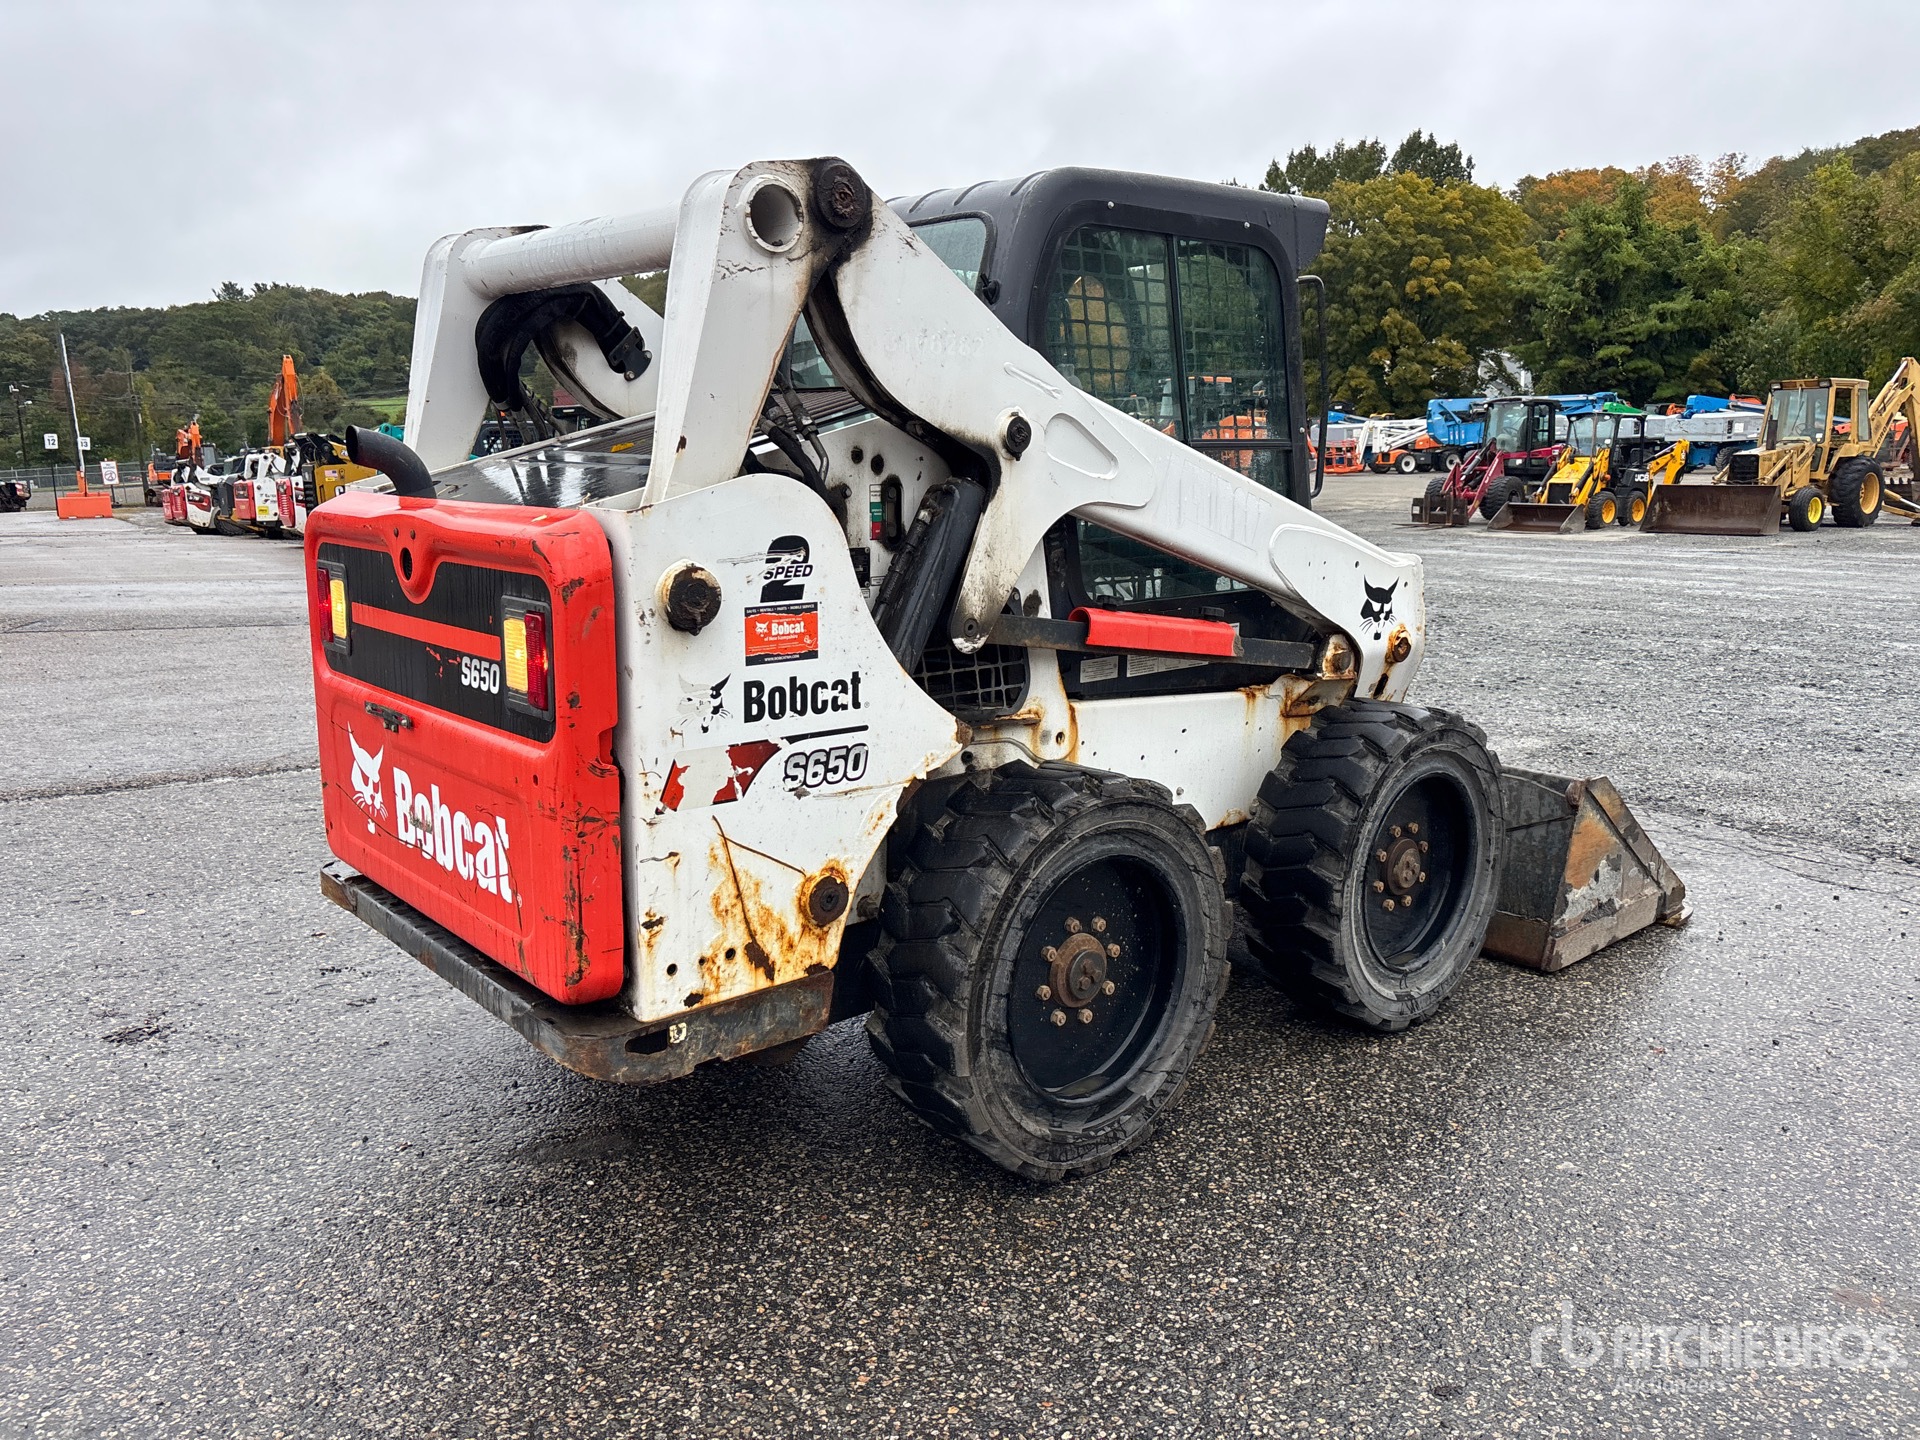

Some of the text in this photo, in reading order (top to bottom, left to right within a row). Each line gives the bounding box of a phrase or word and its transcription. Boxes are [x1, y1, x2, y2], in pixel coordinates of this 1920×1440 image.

[47, 438, 56, 446] 12
[1634, 473, 1649, 483] JCB
[760, 535, 810, 603] 2
[763, 564, 813, 580] SPEED
[772, 622, 804, 636] Bobcat
[461, 656, 500, 695] S650
[743, 671, 862, 724] Bobcat
[783, 742, 869, 793] S650
[393, 767, 513, 904] Bobcat
